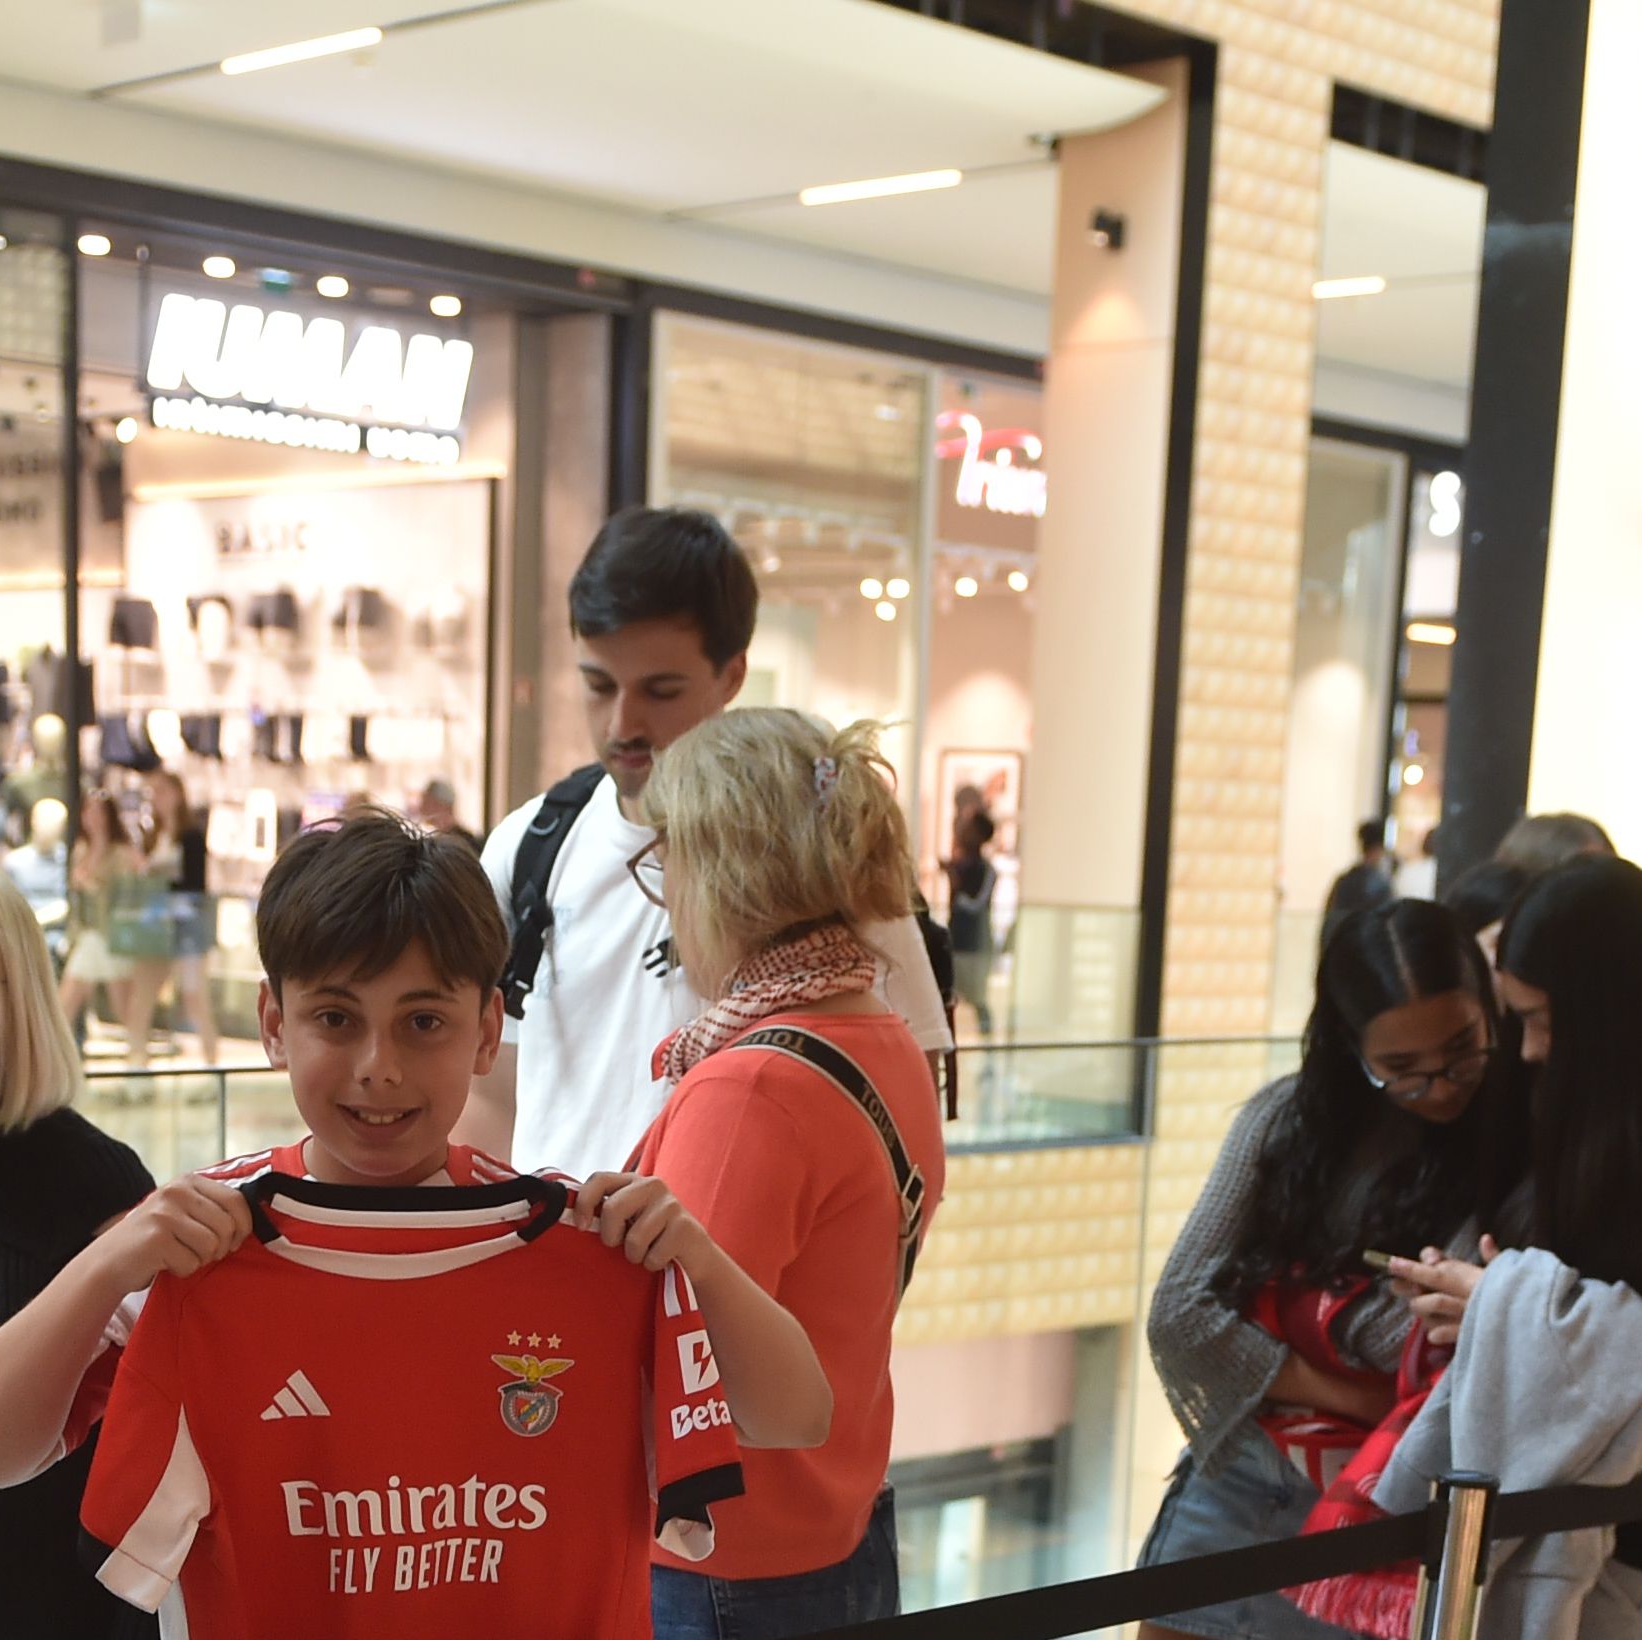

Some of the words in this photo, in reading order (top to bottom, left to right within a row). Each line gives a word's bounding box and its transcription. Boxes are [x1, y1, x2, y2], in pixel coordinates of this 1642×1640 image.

[280, 1473, 548, 1537] Emirates
[329, 1547, 381, 1594] FLY
[393, 1537, 504, 1592] BETTER
